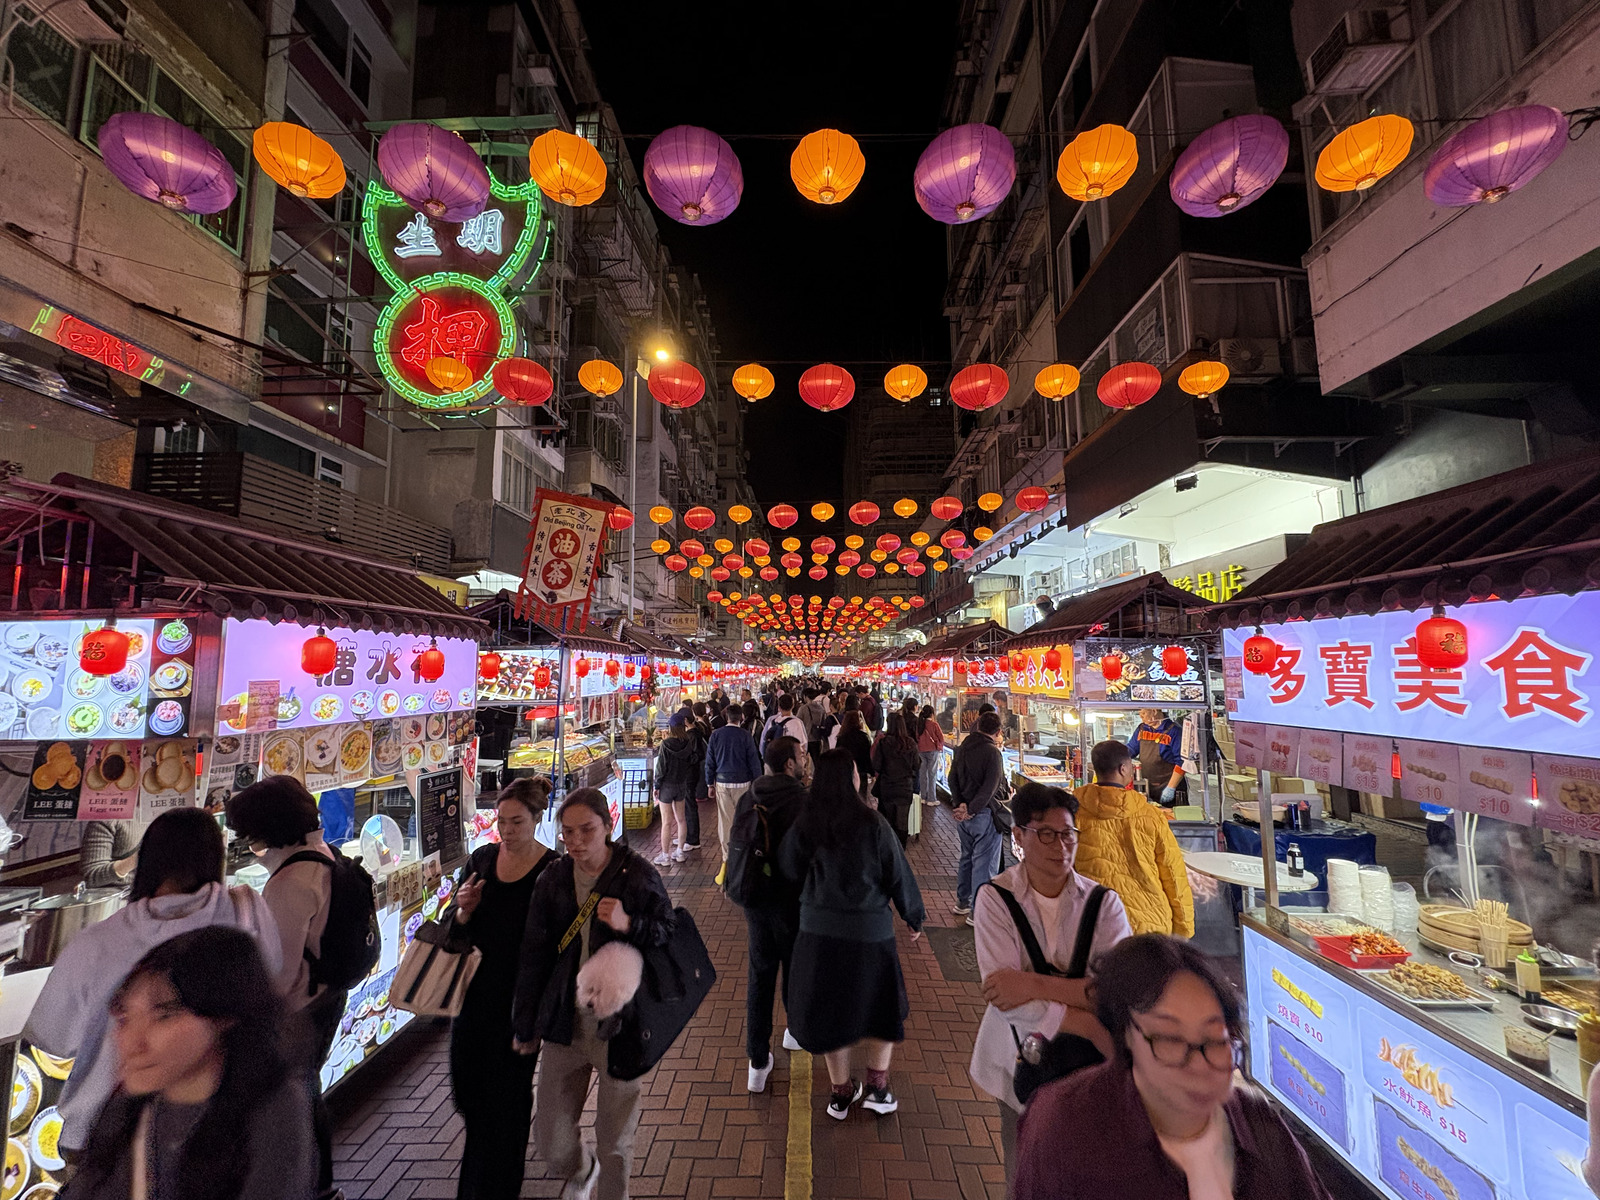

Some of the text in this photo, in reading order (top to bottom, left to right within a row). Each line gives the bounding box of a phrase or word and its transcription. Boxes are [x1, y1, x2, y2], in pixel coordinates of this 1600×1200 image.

[554, 518, 575, 529] Beijing
[576, 522, 585, 531] Oil
[585, 525, 597, 533] Tea
[83, 641, 106, 661] 福
[1439, 632, 1468, 655] 福
[1245, 647, 1264, 663] 福
[1268, 630, 1588, 723] 多寶美食
[1309, 765, 1330, 780] $15
[1355, 774, 1380, 790] $15
[1416, 785, 1443, 801] $10
[150, 800, 167, 808] LEE
[1479, 795, 1511, 815] $10
[1304, 1023, 1323, 1043] $10
[1307, 1094, 1326, 1117] $10
[1383, 1078, 1467, 1143] 水魷魚 $15
